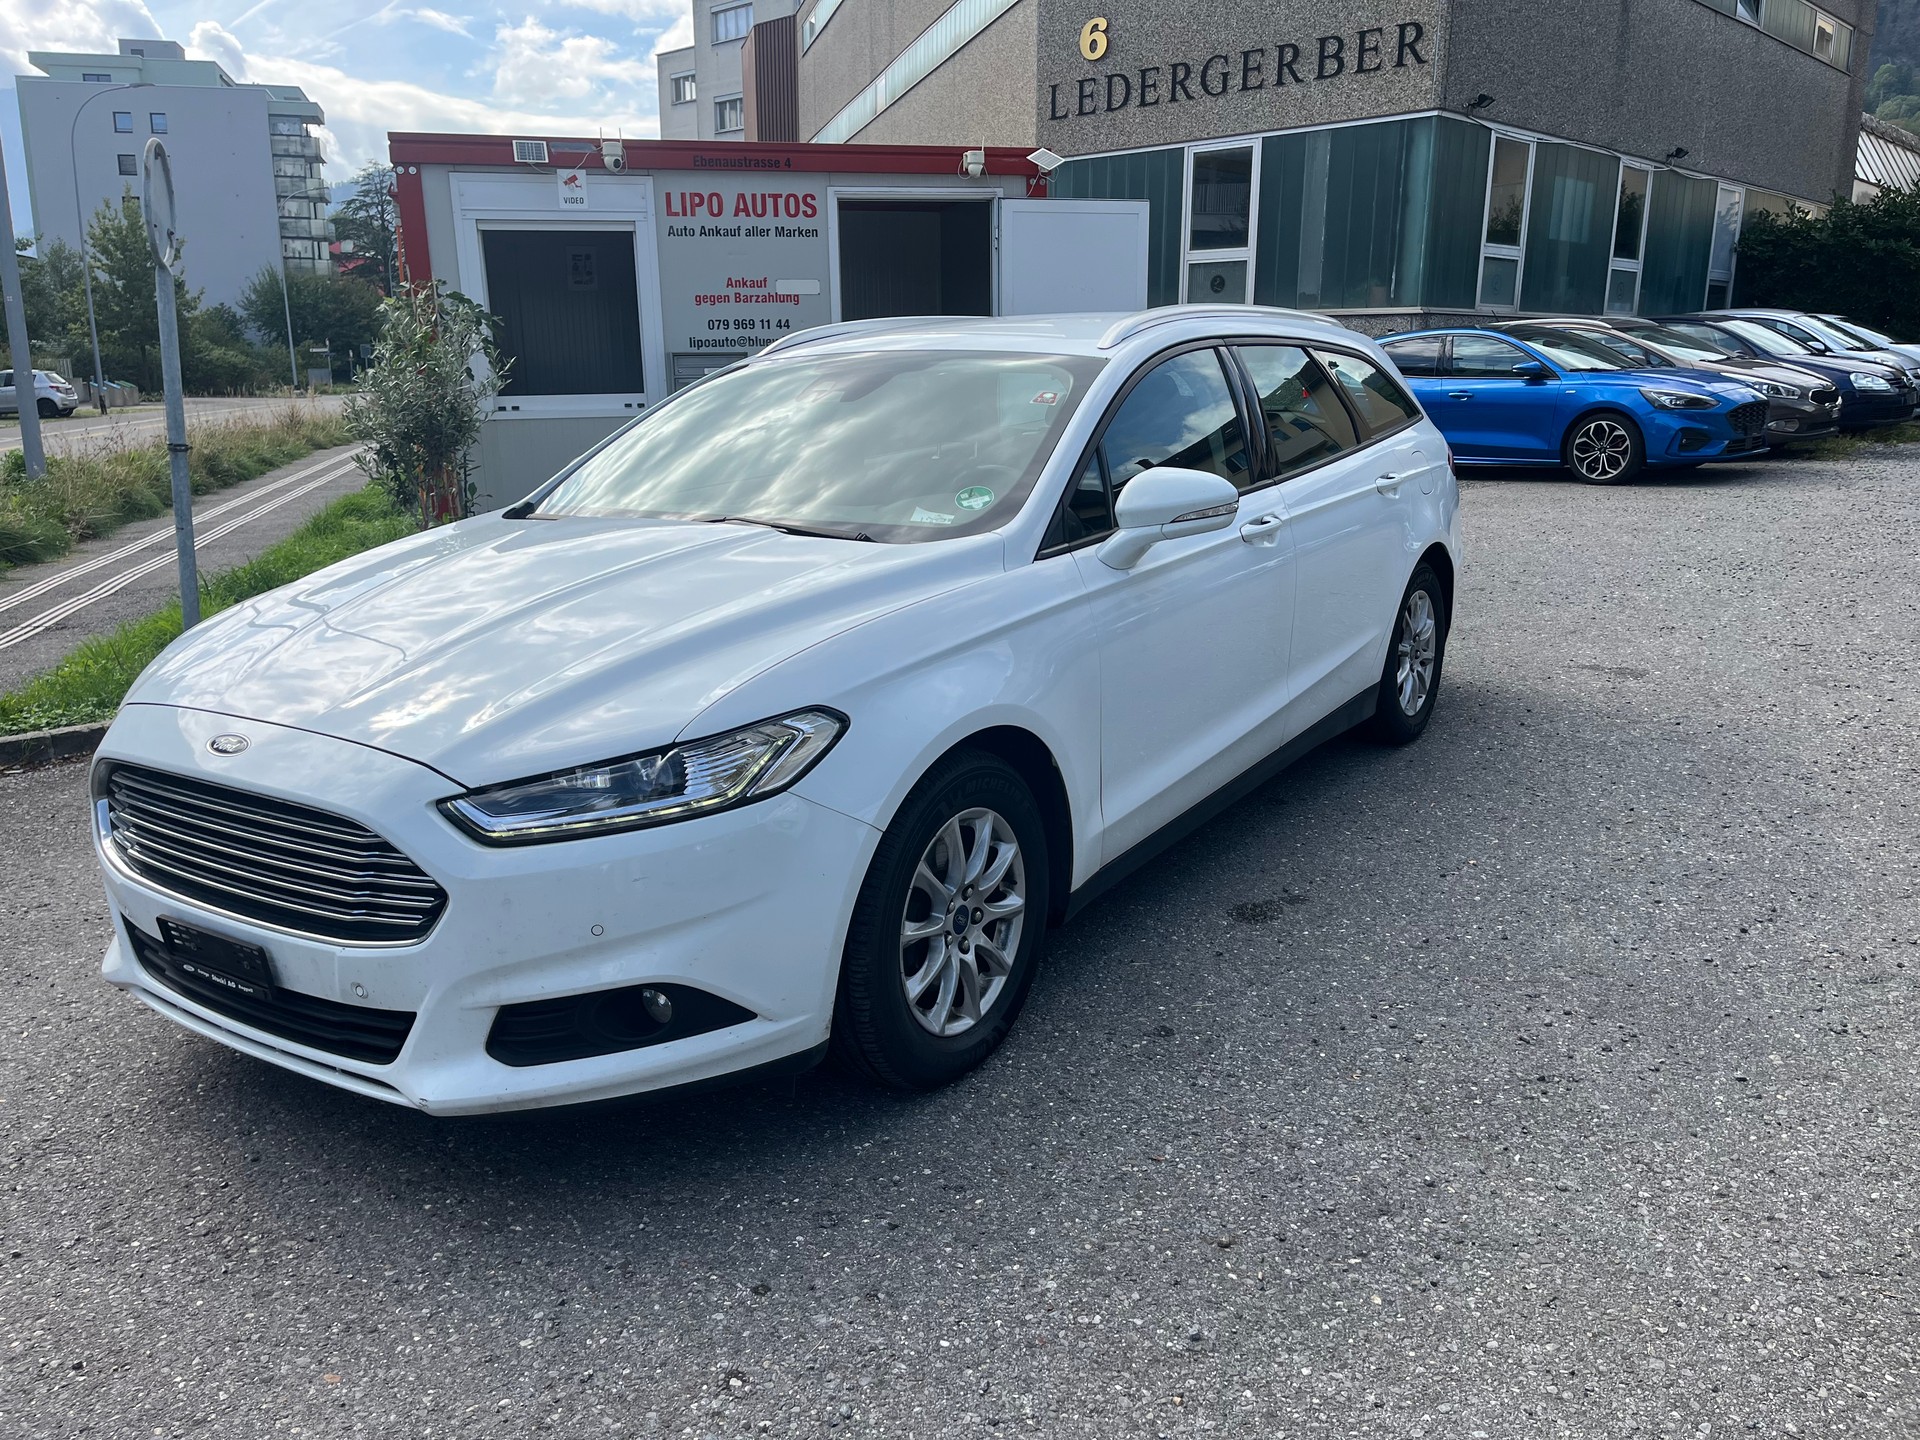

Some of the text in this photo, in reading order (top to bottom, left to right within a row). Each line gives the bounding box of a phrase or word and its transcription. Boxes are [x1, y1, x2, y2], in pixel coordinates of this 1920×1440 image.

[1079, 16, 1108, 61] 6
[1049, 22, 1427, 121] LEDERGERBER
[693, 155, 792, 168] Ebenaustrasse 4
[563, 197, 584, 205] VIDEO
[665, 191, 818, 218] LIPO AUTOS
[667, 225, 818, 238] Auto Ankauf aller Marken
[726, 277, 768, 288] Ankauf
[694, 292, 800, 306] gegen Barzahlung
[707, 318, 791, 330] 079 969 11 44
